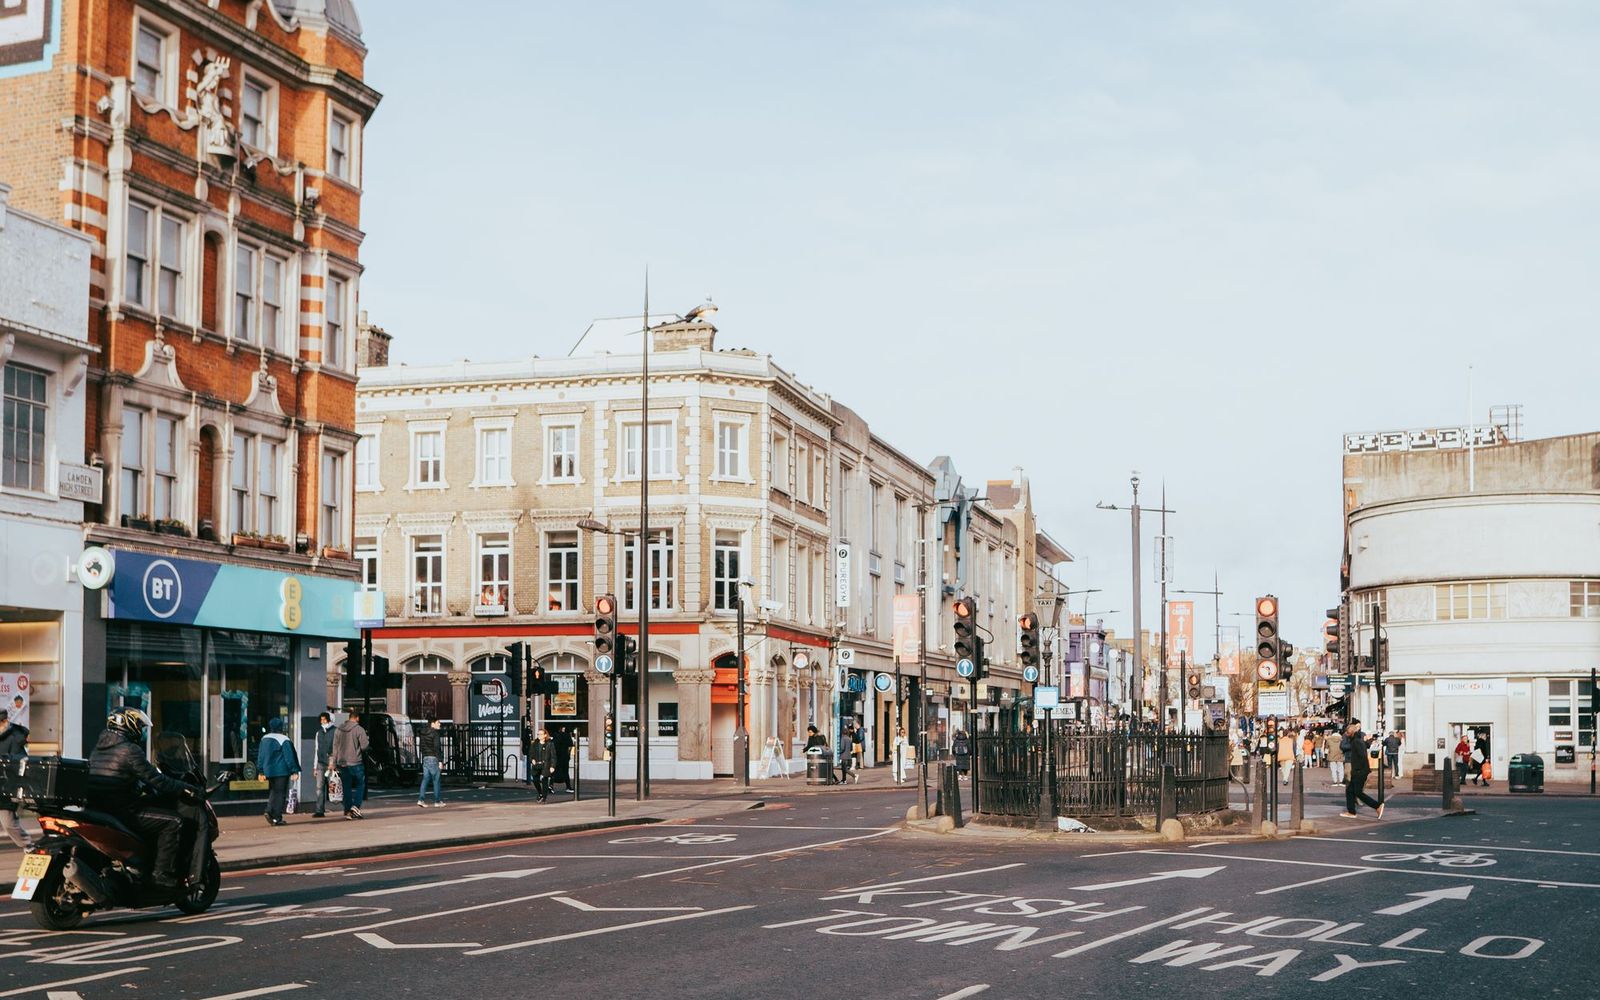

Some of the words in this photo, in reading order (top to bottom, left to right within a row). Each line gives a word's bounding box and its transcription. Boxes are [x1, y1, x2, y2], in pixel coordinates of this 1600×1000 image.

[59, 481, 74, 491] HIGH
[74, 484, 94, 497] STREET
[67, 472, 93, 486] CAMDEN
[152, 577, 173, 600] BT
[839, 561, 848, 602] PUREGYM
[761, 909, 1085, 951] TOWN
[1169, 911, 1545, 959] HOLLO
[1128, 939, 1407, 982] WAY
